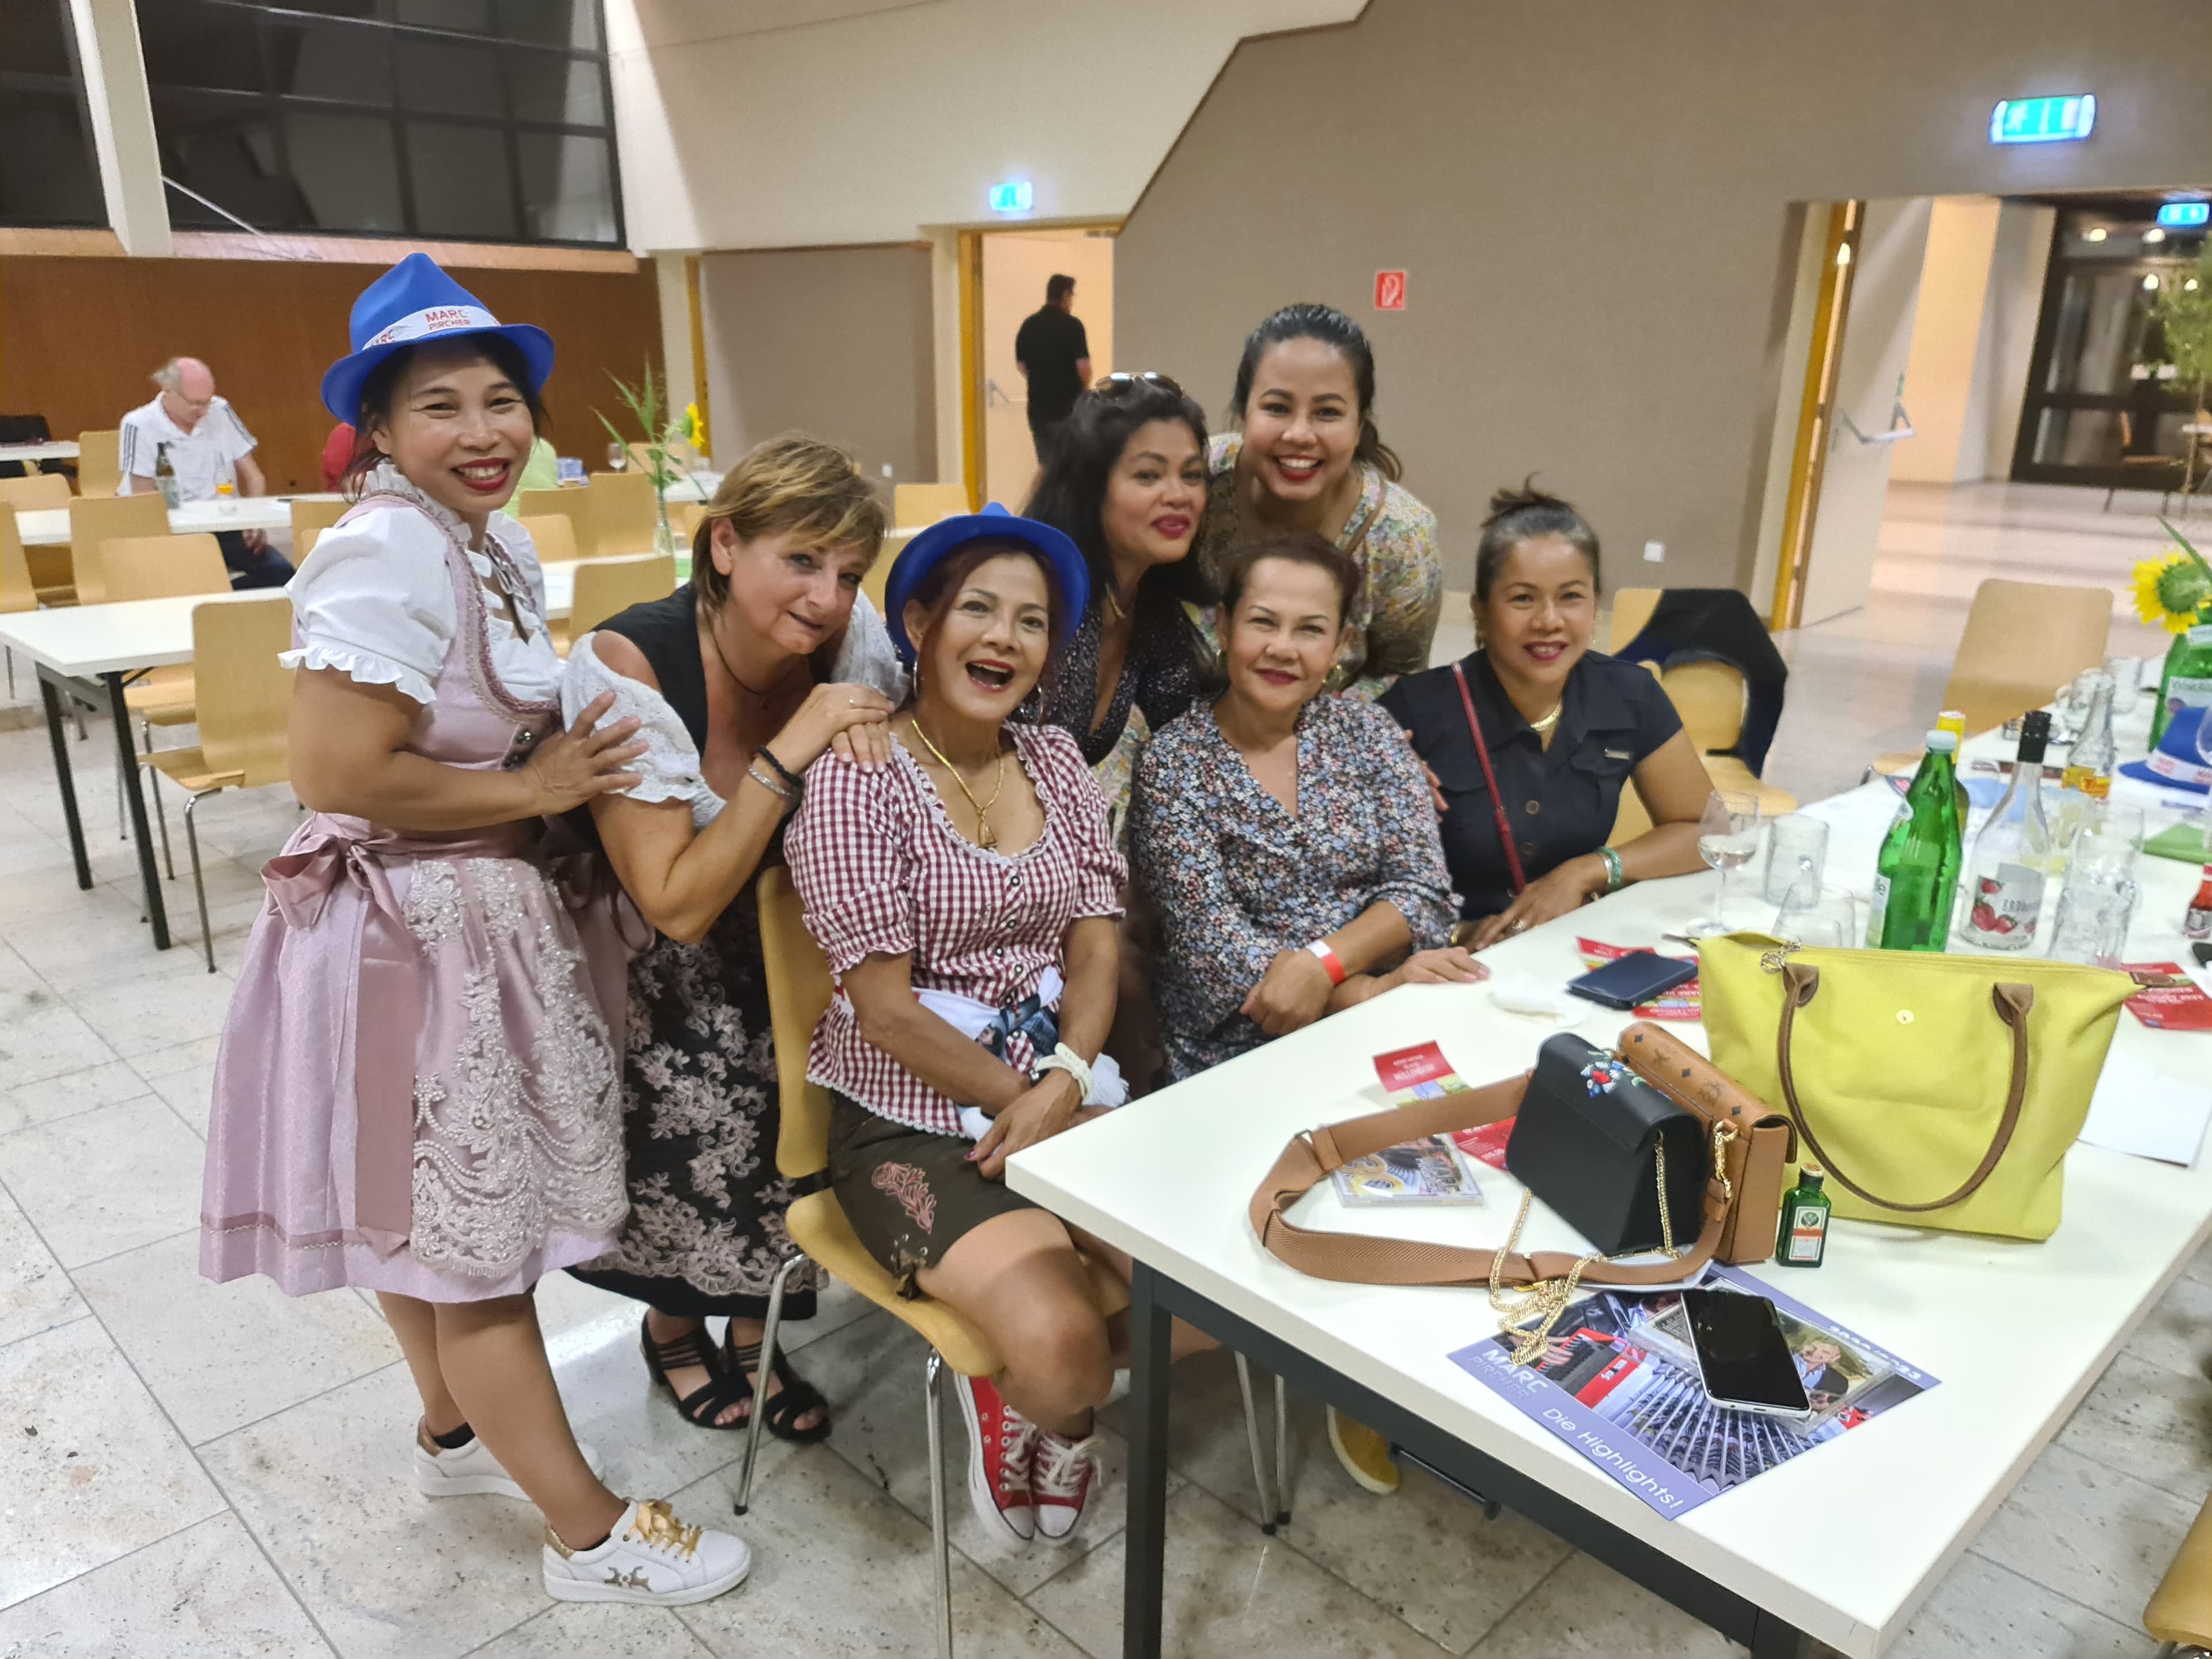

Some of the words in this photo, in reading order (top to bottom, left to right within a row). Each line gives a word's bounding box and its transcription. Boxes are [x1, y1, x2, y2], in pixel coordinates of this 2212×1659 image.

[425, 309, 468, 323] MARC
[429, 319, 471, 331] PIRCHER
[1482, 1349, 1548, 1393] MARC
[1542, 1407, 1576, 1431] Die
[1577, 1430, 1684, 1509] Highlights!
